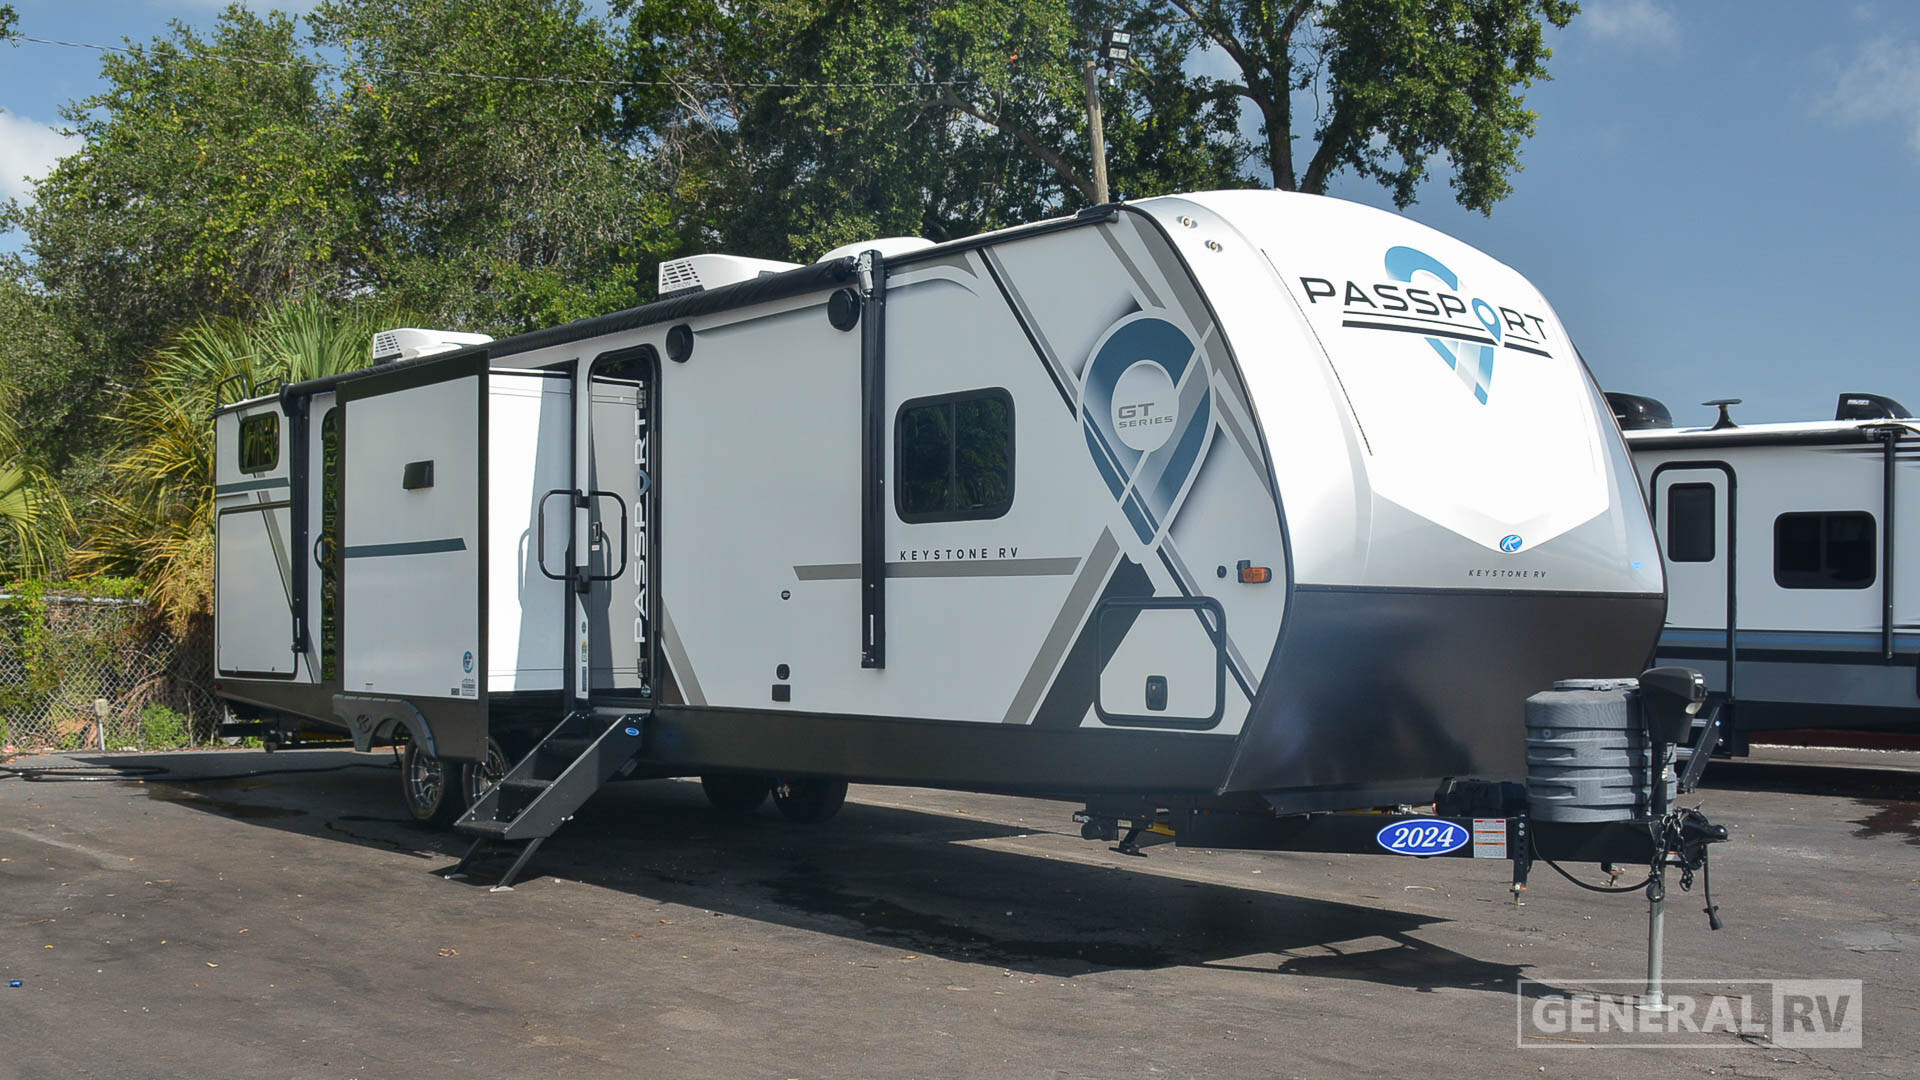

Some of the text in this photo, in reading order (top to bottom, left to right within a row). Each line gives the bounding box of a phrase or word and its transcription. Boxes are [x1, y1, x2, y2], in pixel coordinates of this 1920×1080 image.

[1299, 276, 1547, 341] PASSPORT
[1118, 402, 1155, 419] GT
[1118, 415, 1174, 429] SERIES
[633, 409, 651, 643] PASSPORT
[899, 547, 1018, 561] KEYSTONE RV
[1468, 569, 1528, 578] KEYSTONE
[1391, 826, 1454, 848] 2024
